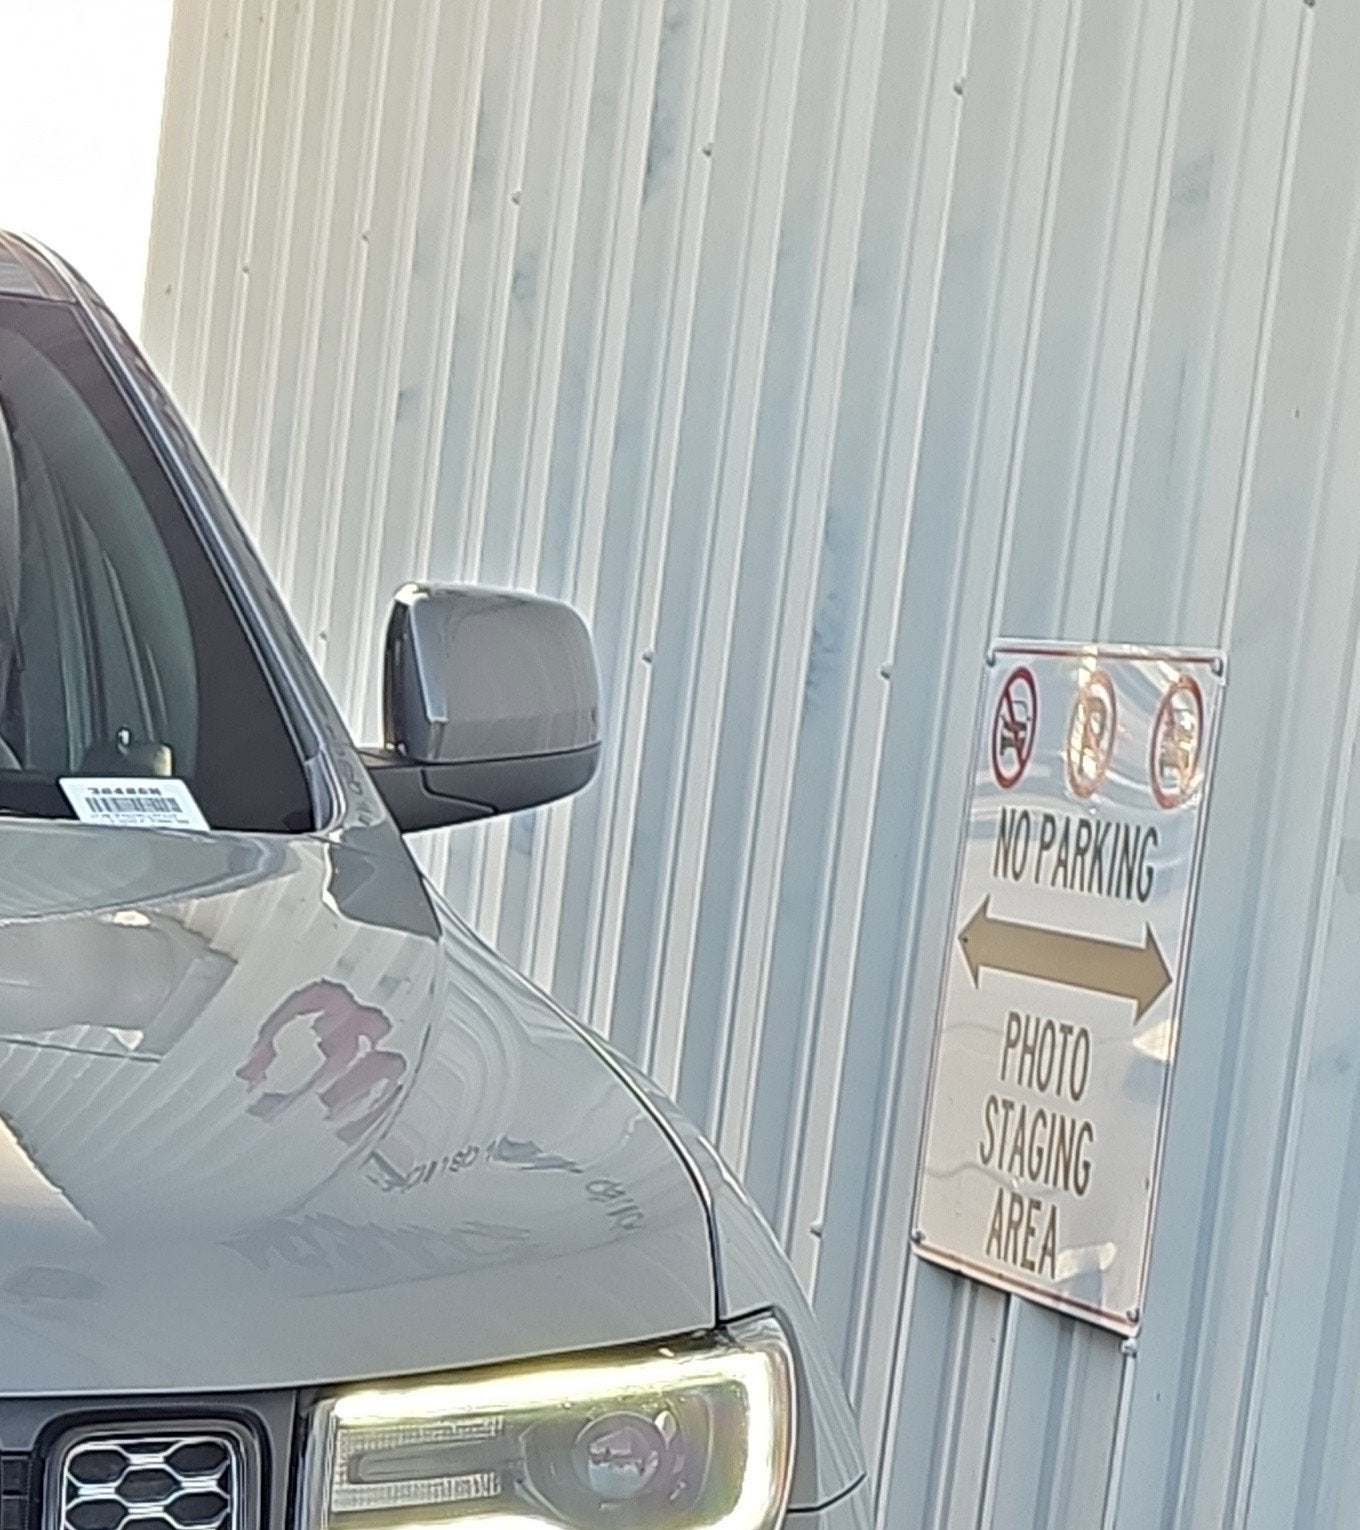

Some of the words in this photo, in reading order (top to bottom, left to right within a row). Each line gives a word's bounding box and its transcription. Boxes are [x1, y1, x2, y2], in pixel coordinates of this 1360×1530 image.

[993, 806, 1031, 881] NO
[1035, 812, 1159, 903] PARKING
[1000, 1010, 1091, 1103] PHOTO
[980, 1094, 1094, 1197] STAGING
[985, 1187, 1058, 1280] AREA
